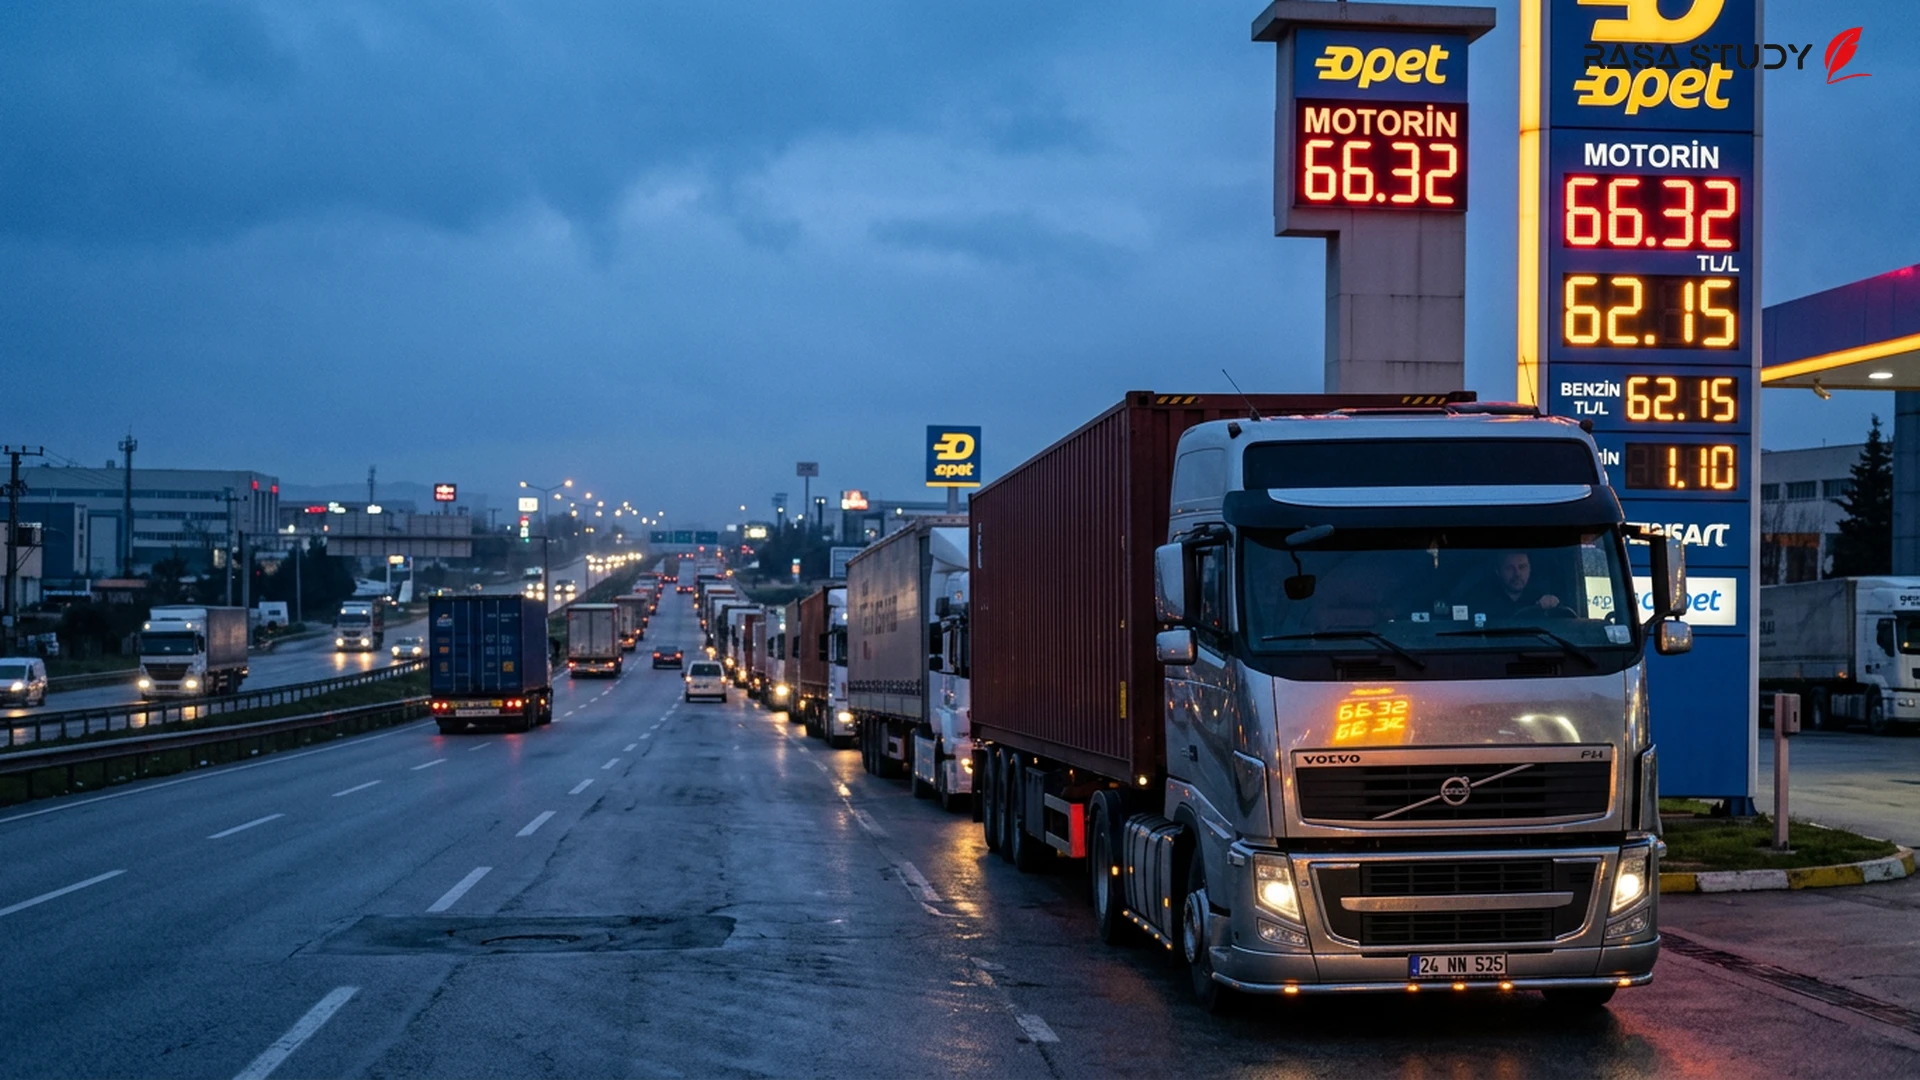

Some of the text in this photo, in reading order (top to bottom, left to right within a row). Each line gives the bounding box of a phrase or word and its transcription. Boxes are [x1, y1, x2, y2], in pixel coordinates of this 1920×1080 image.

[1304, 104, 1458, 138] MOTORİN
[1304, 139, 1458, 204] 66.32
[1584, 140, 1720, 169] MOTORİN
[1566, 177, 1736, 248] 66.32
[1565, 276, 1736, 346] 62.15
[1561, 380, 1621, 397] BENZİN
[1627, 376, 1735, 422] 62.15
[1668, 445, 1734, 490] 1.10
[1420, 957, 1439, 973] 24
[1447, 957, 1467, 973] NN
